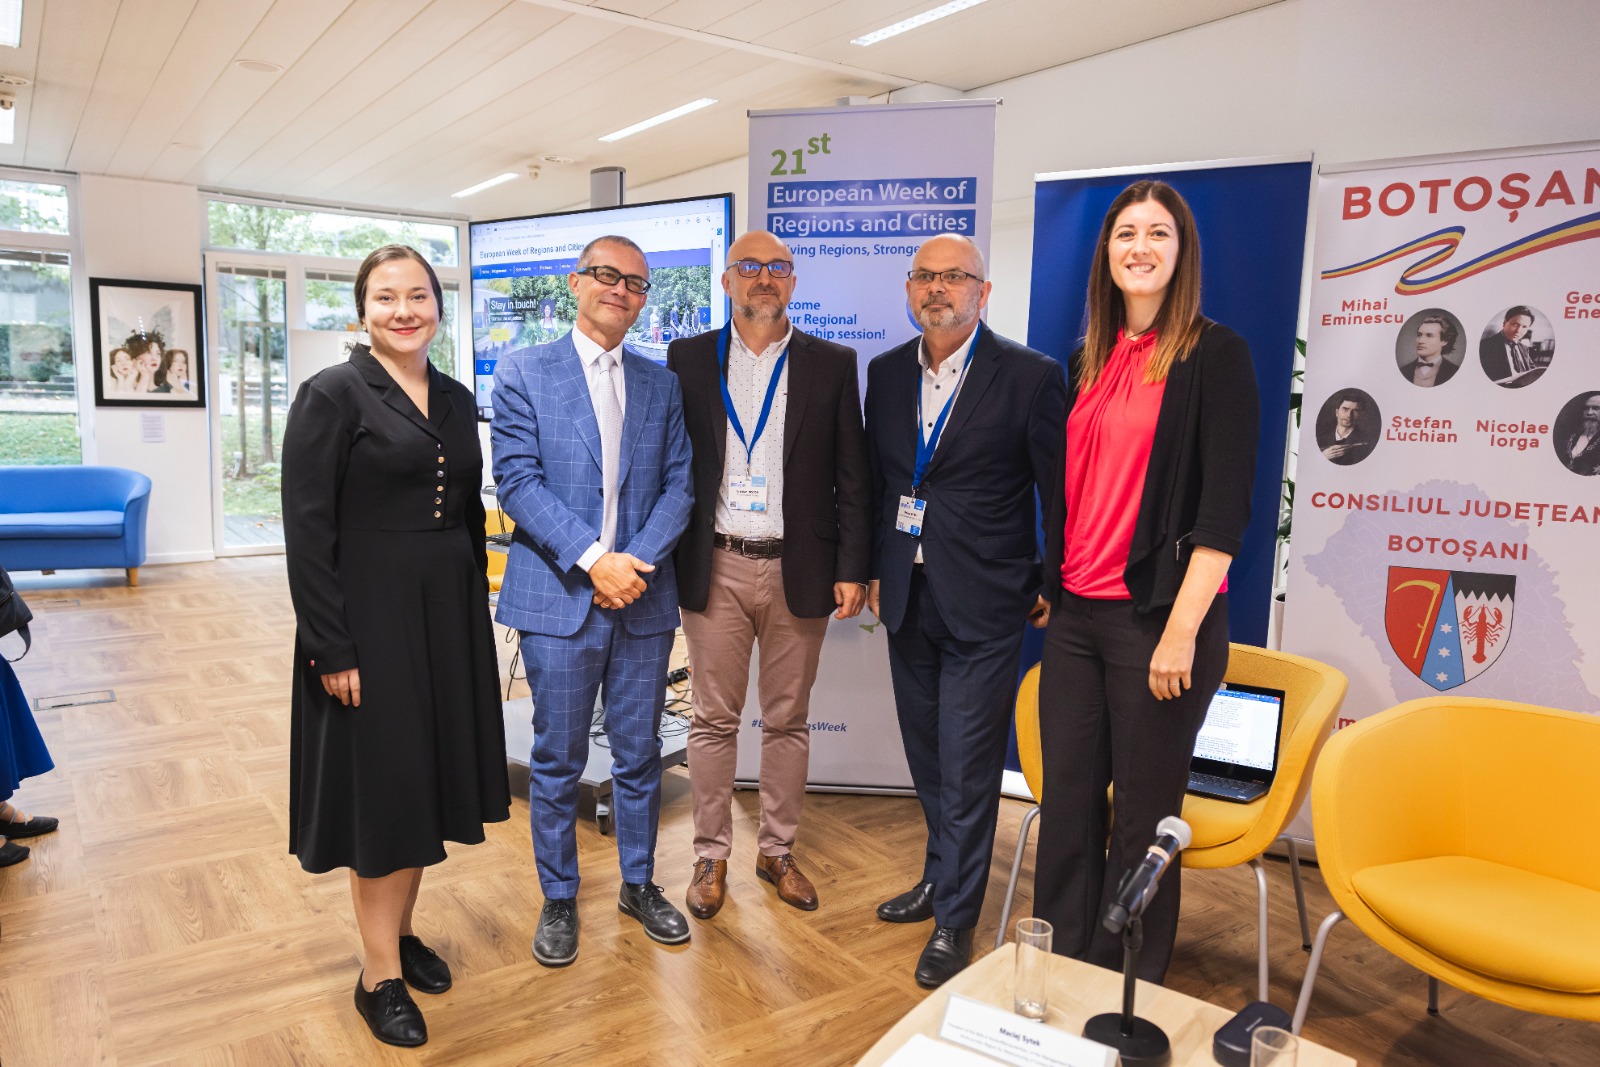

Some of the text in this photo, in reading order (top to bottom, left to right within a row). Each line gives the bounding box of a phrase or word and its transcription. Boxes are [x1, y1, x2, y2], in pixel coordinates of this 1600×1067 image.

[770, 133, 831, 175] 21st
[773, 181, 968, 206] European Week of
[772, 213, 968, 236] Regions and Cities
[480, 250, 506, 259] European
[530, 246, 554, 256] Regions
[555, 244, 567, 252] and
[787, 244, 816, 257] ving
[819, 244, 870, 257] Regions,
[490, 298, 536, 311] Stay in touch!
[1341, 298, 1388, 312] Mihai
[804, 313, 857, 327] Regional
[1321, 313, 1404, 326] Eminescu
[838, 329, 885, 339] session!
[1391, 415, 1452, 432] Ștefan
[1476, 419, 1549, 434] Nicolae
[1386, 429, 1457, 443] Luchian
[1490, 434, 1540, 451] Iorga
[1311, 491, 1450, 515] CONSILIUL
[1387, 534, 1528, 562] BOTOȘANI
[999, 1027, 1021, 1041] Maciej
[1022, 1035, 1040, 1046] Sytek
